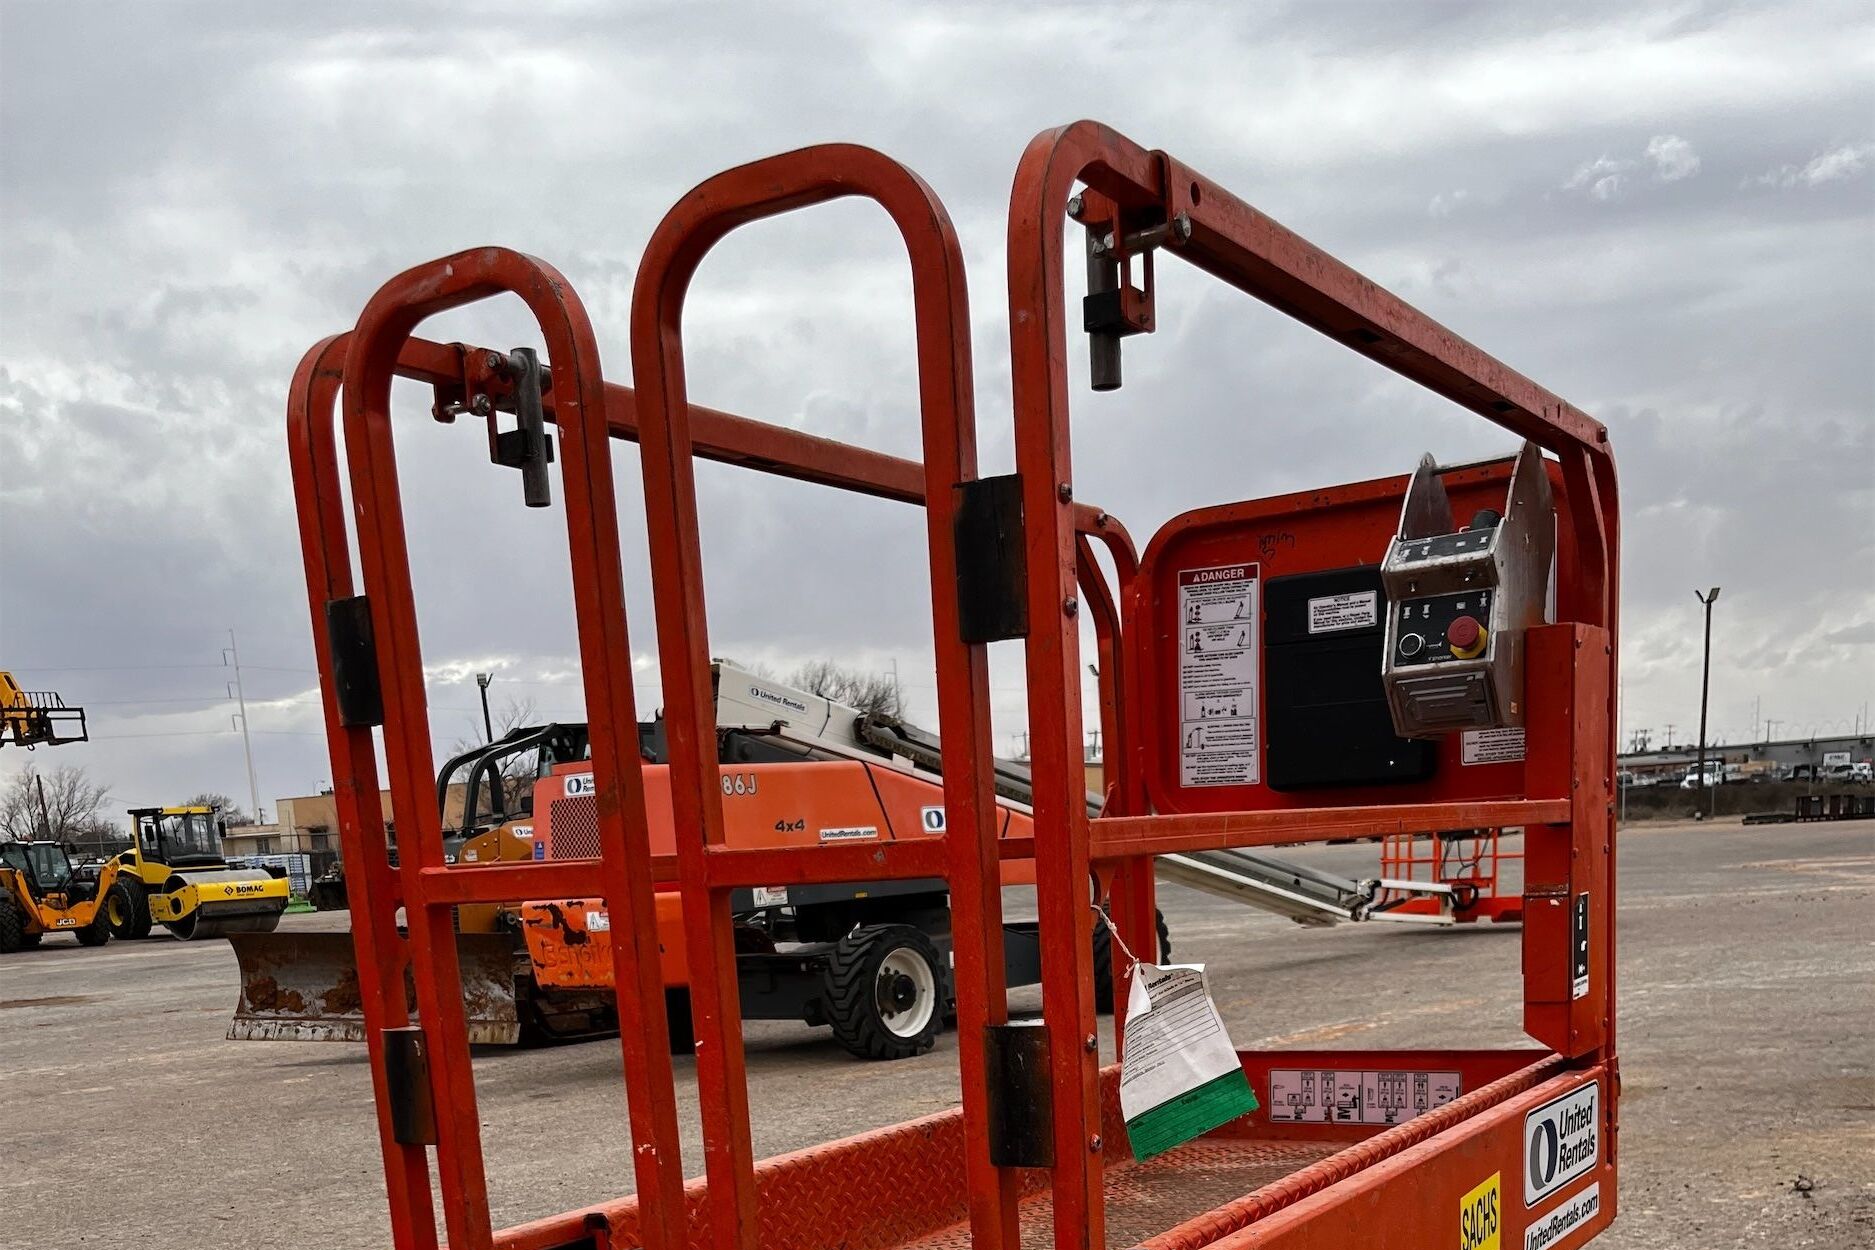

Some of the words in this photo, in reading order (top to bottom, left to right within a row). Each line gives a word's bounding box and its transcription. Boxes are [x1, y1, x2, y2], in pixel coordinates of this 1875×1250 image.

[1201, 568, 1245, 582] DANGER
[760, 690, 783, 704] United
[783, 698, 806, 712] Rentals
[722, 773, 757, 796] 86J
[775, 818, 806, 833] 4x4
[821, 828, 877, 839] UnitedRentals.com
[235, 884, 264, 894] BOMAG
[1559, 1095, 1594, 1140] United
[1558, 1128, 1596, 1175] Rentals
